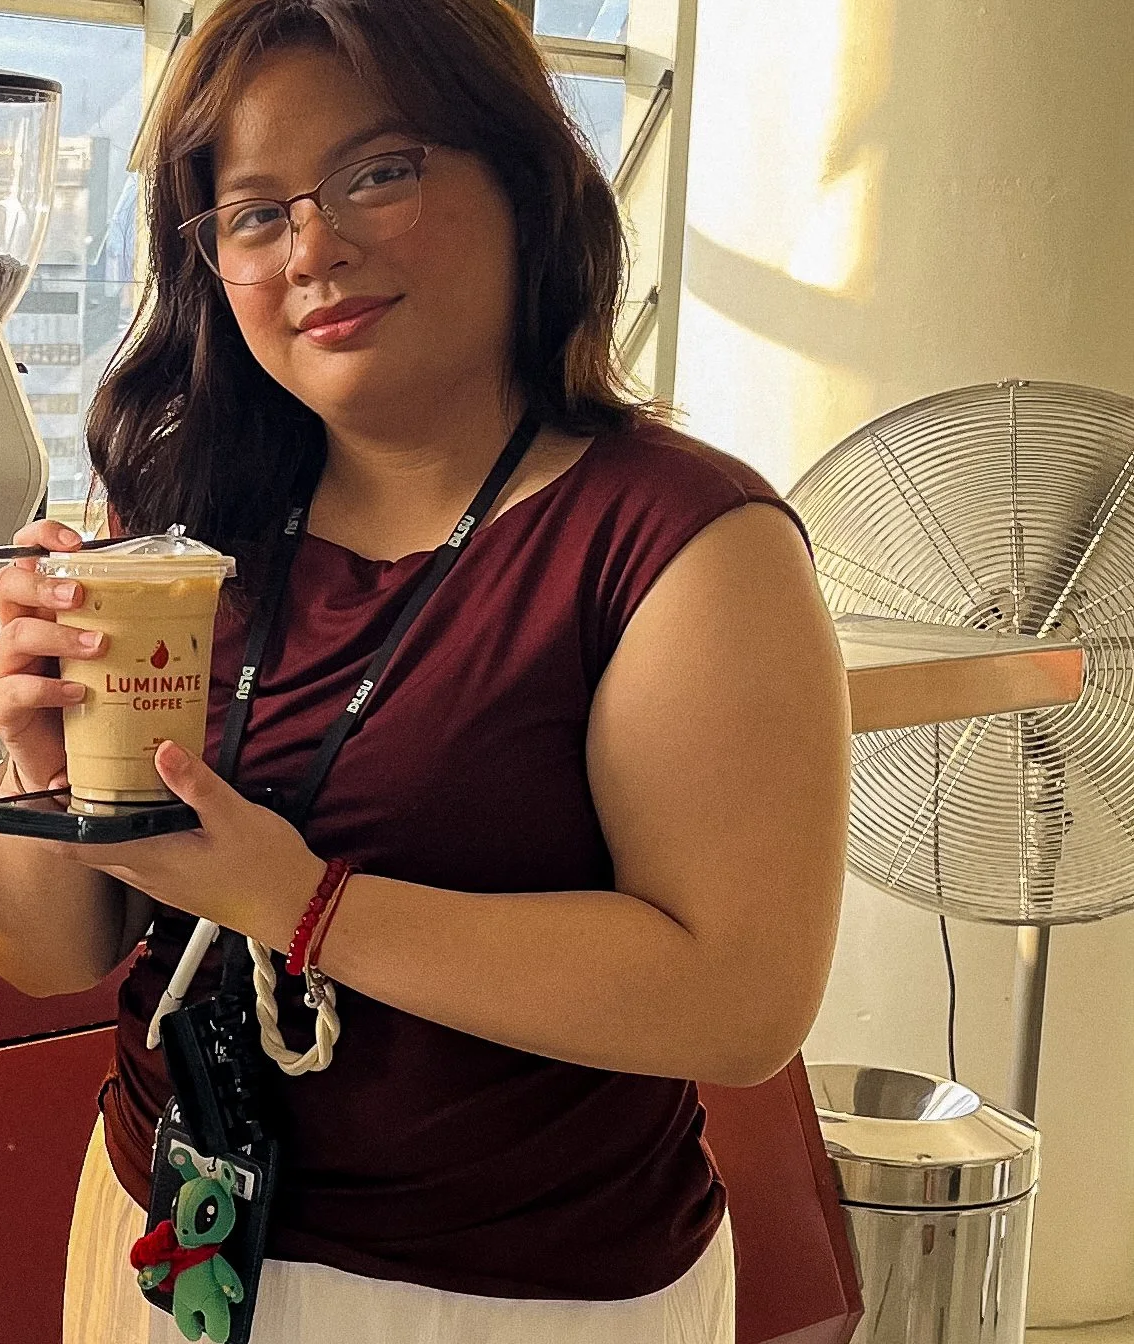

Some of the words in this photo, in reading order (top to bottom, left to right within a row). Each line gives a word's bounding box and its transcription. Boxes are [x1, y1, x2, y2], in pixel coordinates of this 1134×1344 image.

[448, 514, 475, 549] DLSU
[106, 674, 201, 694] LUMINATE
[235, 665, 256, 701] DLSU
[346, 679, 374, 714] DLSU
[133, 697, 182, 711] COFFEE
